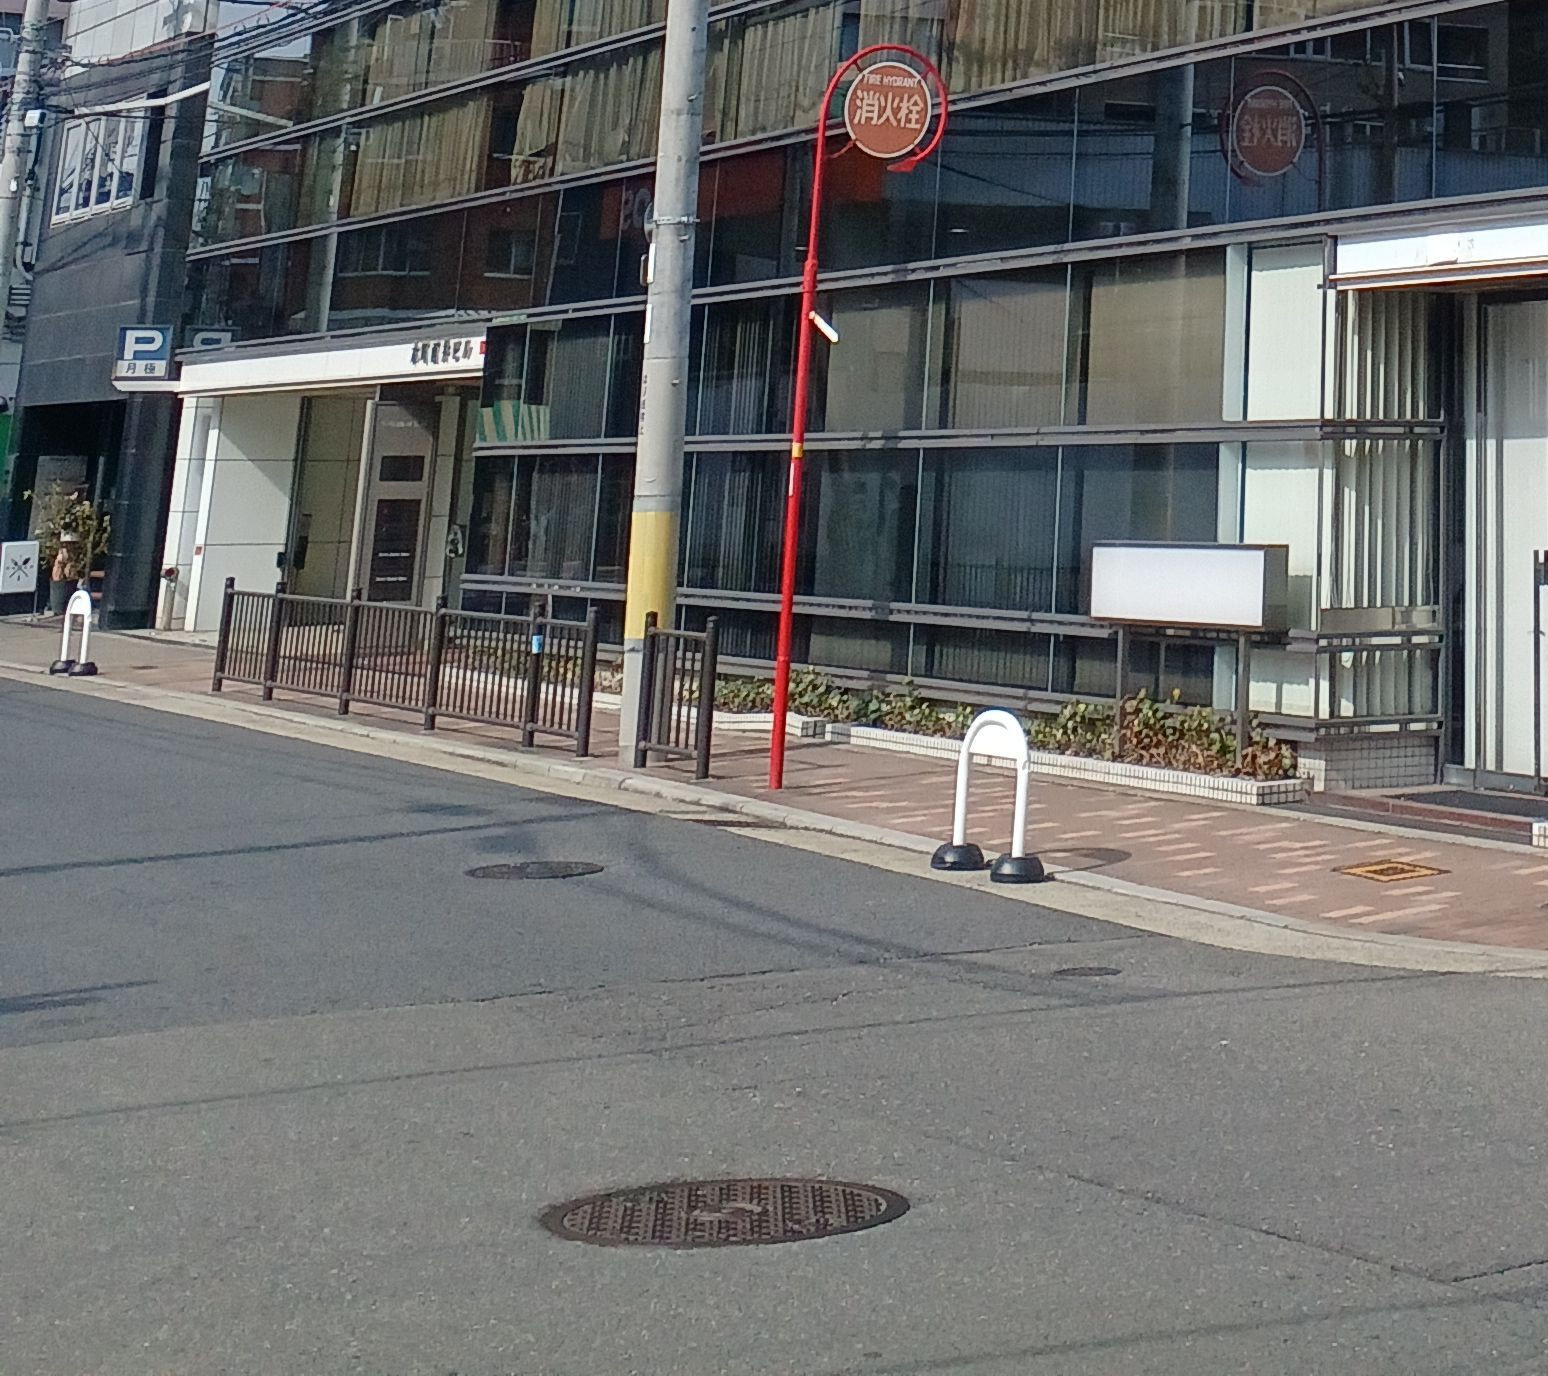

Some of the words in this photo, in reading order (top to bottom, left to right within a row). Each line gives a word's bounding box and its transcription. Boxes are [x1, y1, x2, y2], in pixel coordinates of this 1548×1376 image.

[853, 89, 924, 129] 消火栓
[123, 330, 164, 360] P
